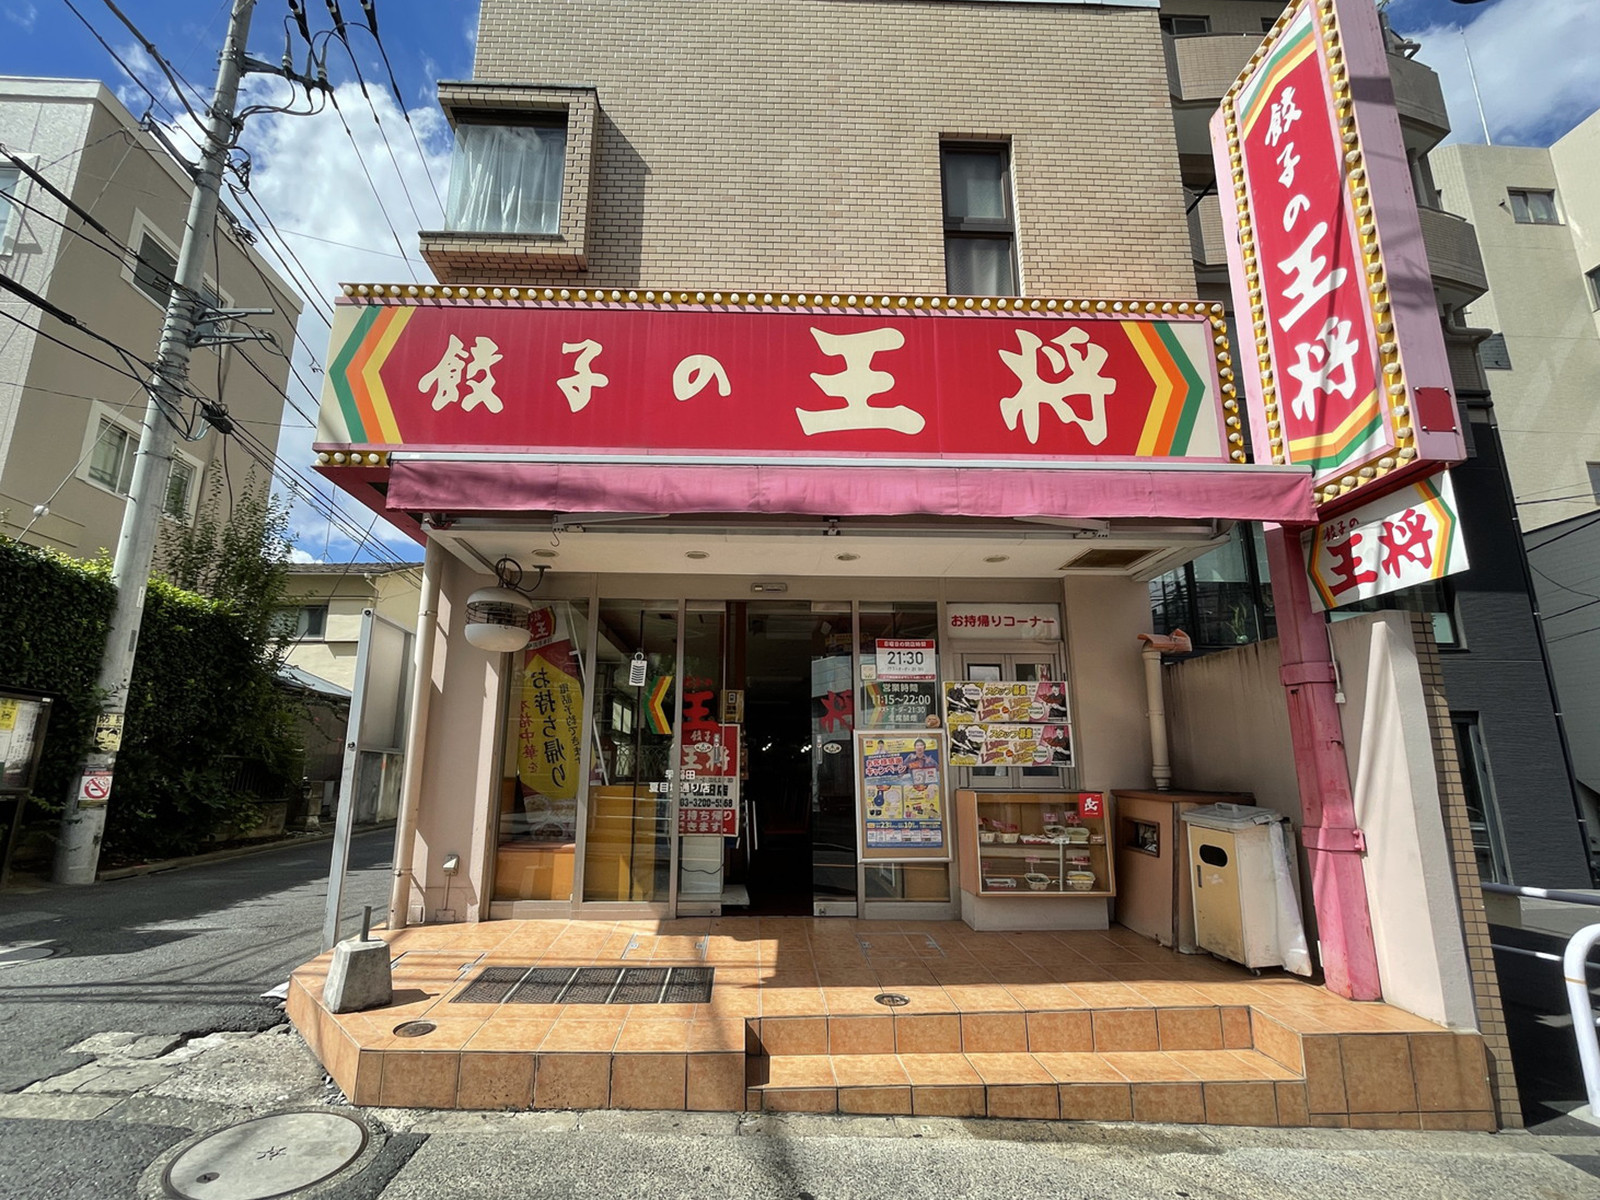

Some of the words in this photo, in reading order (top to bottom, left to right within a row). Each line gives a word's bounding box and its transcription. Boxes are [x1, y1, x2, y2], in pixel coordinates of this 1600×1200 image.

[1264, 86, 1359, 421] 餃子の王将
[419, 326, 1118, 446] 餃子の王将
[1323, 517, 1360, 542] 餃子の
[1326, 508, 1433, 598] 王将
[951, 614, 1055, 628] お持帰りコーナー
[887, 651, 924, 665] 21:30
[882, 683, 919, 693] 営業時間
